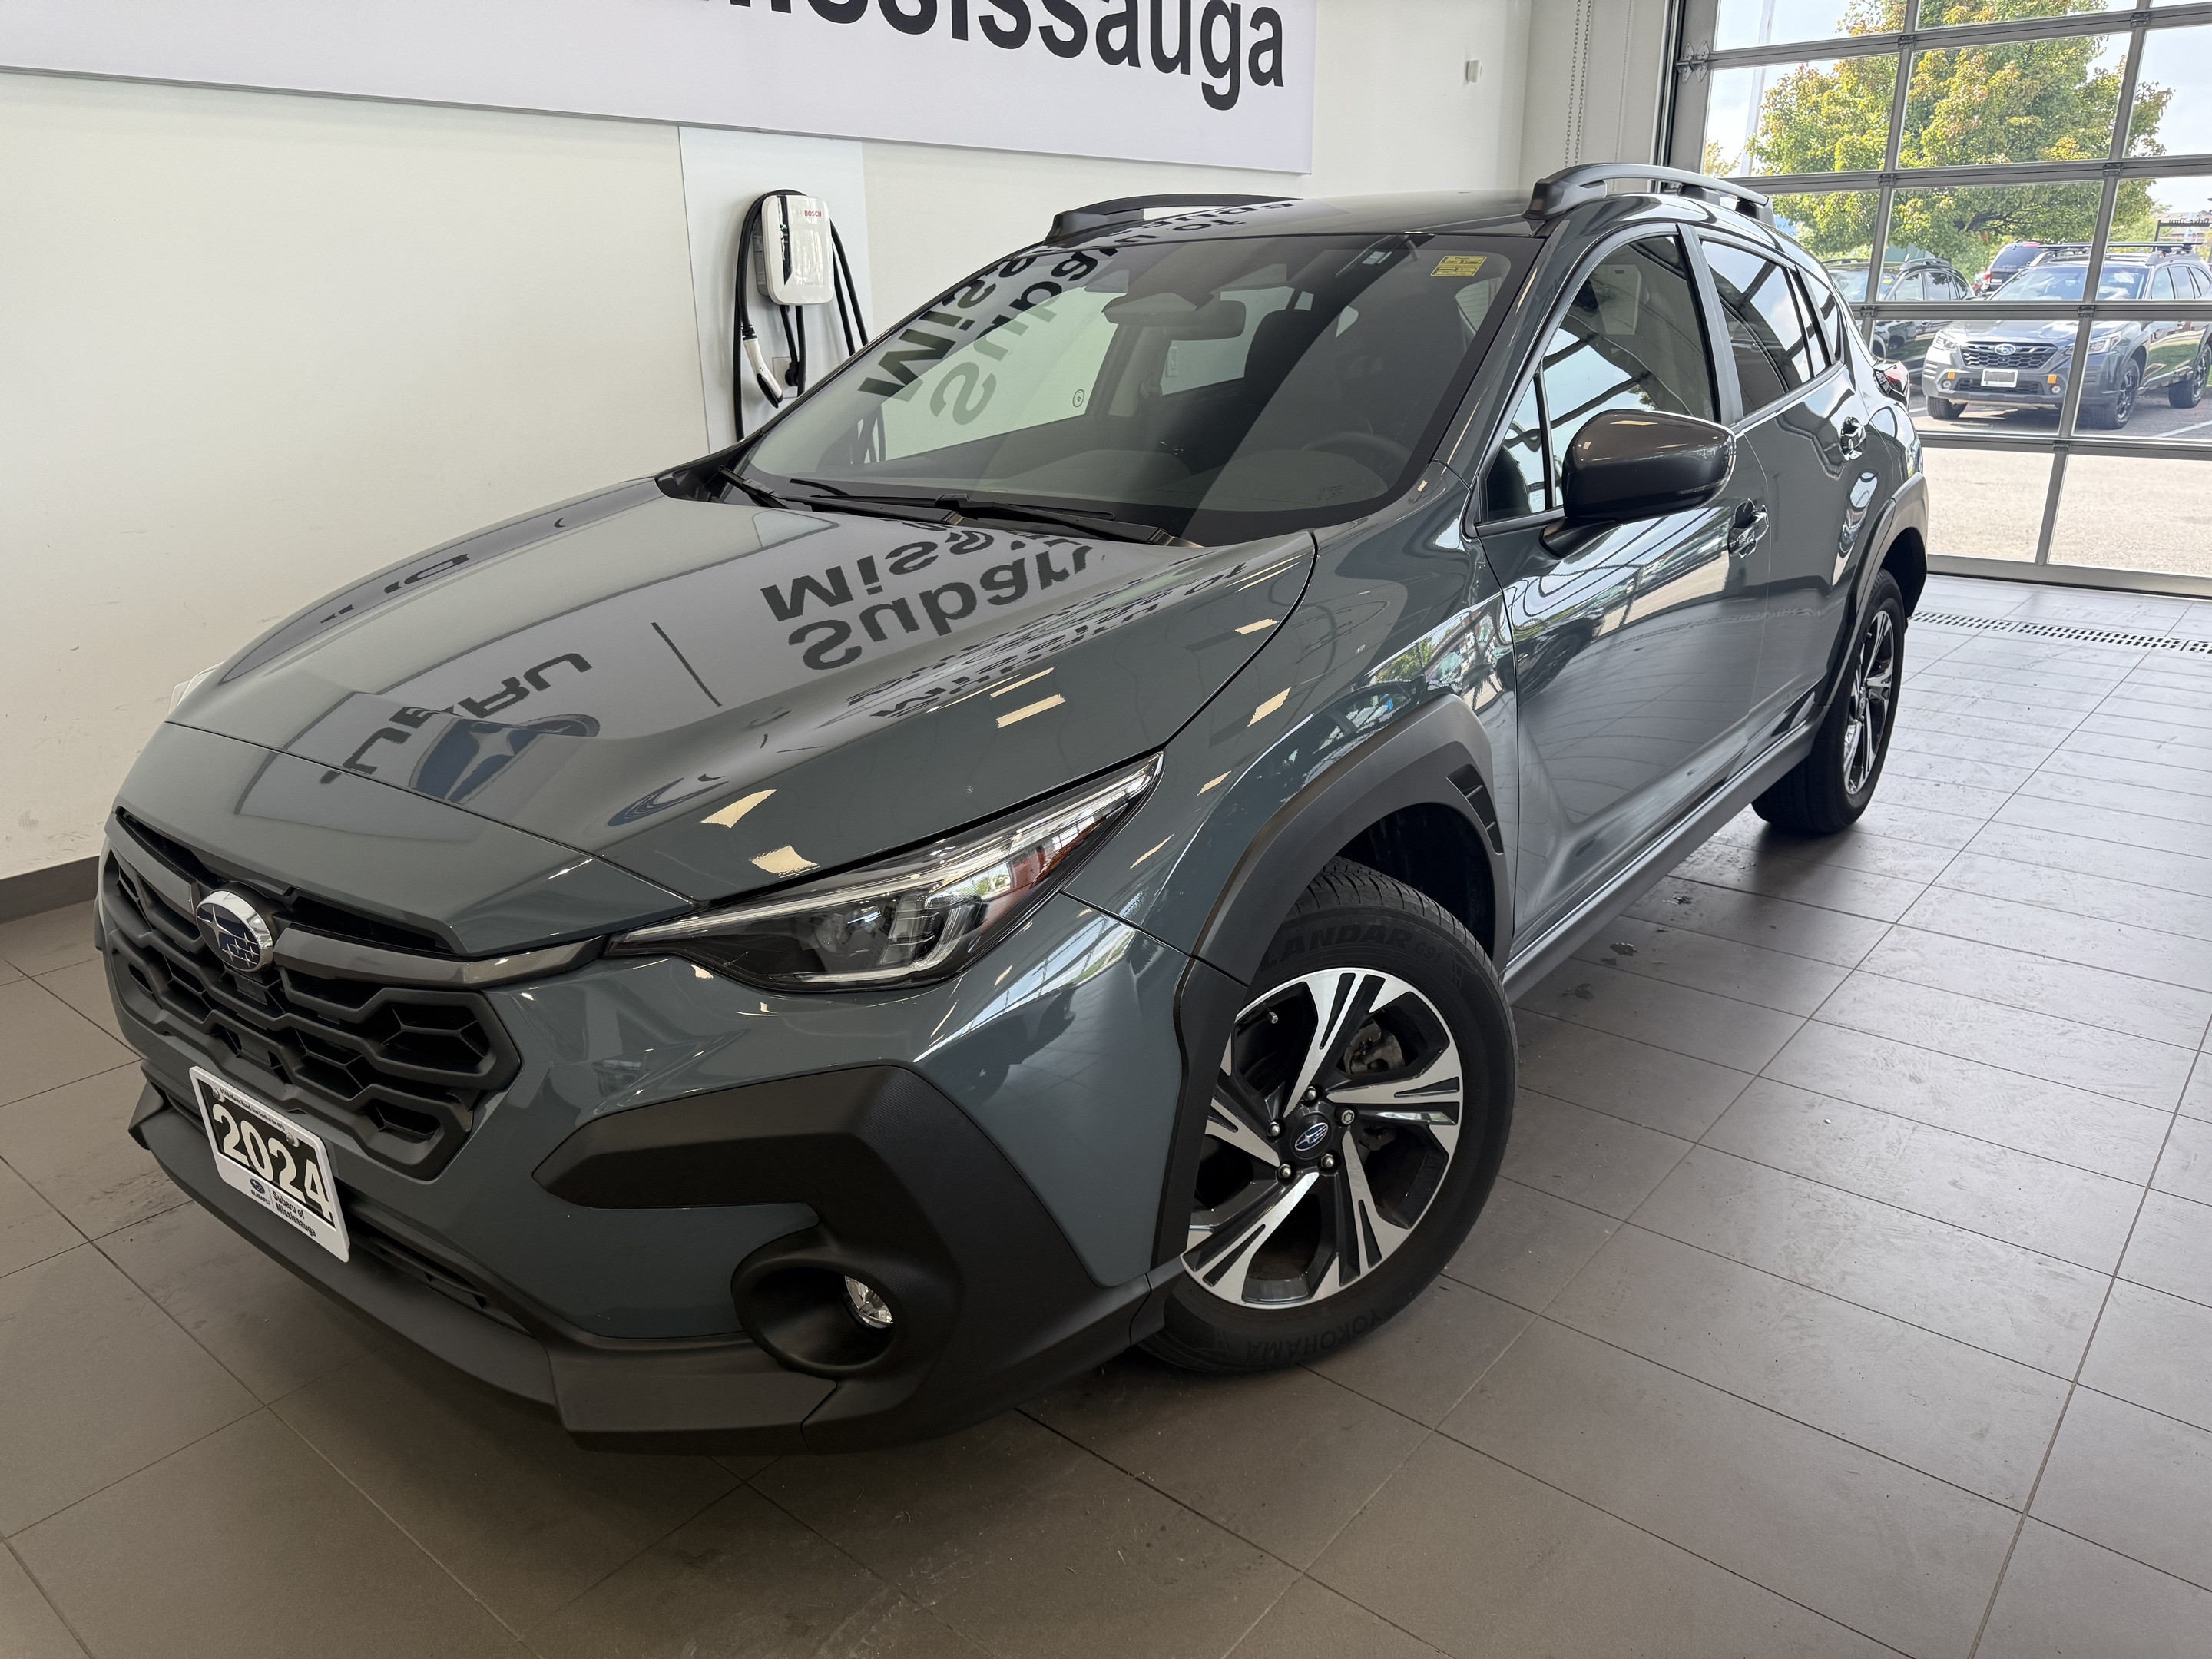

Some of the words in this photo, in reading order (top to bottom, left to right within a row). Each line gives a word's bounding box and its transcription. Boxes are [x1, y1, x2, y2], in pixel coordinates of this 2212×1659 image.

[212, 1103, 333, 1223] 2024
[273, 1190, 296, 1214] Subaru
[297, 1209, 305, 1220] of
[275, 1201, 317, 1238] Mississauga
[1246, 1309, 1382, 1361] YOKOHAMA
